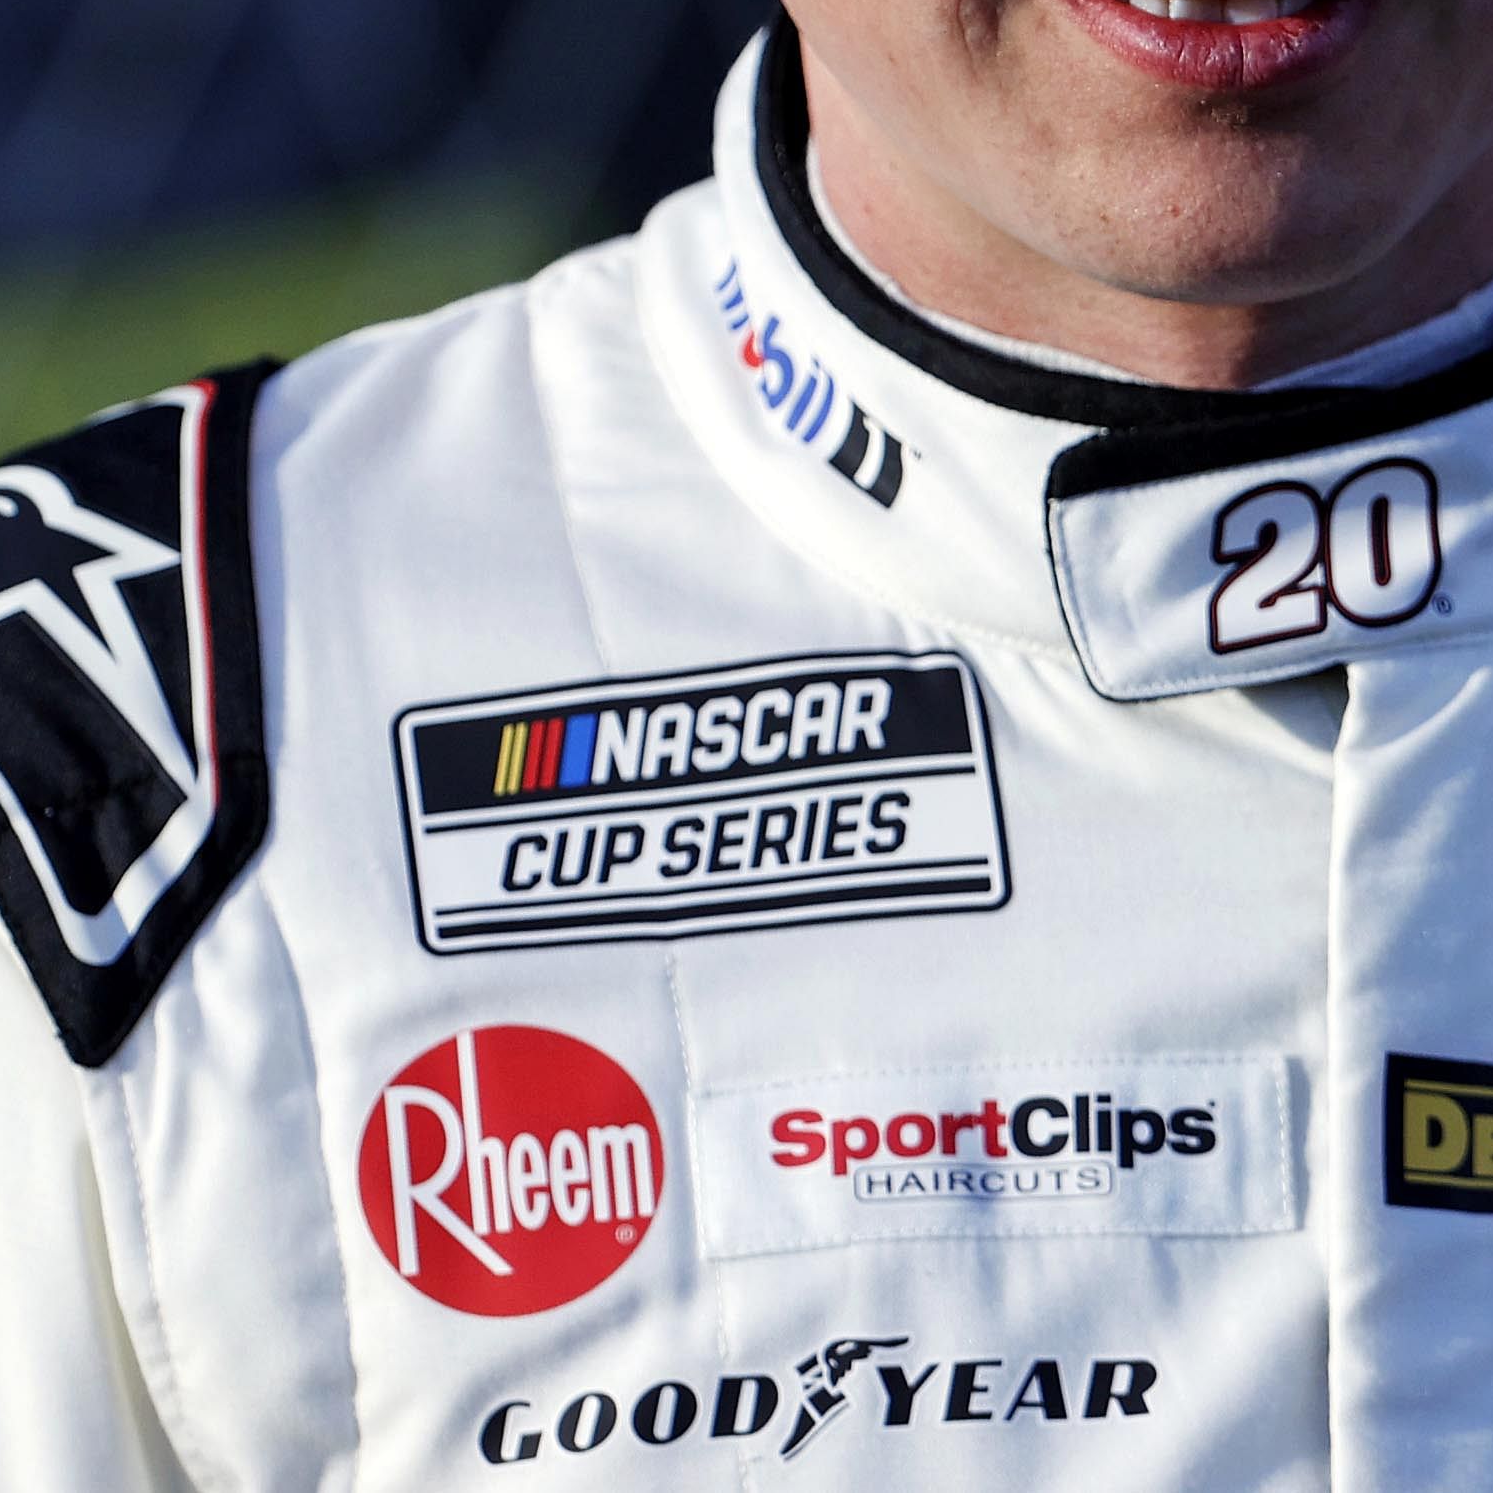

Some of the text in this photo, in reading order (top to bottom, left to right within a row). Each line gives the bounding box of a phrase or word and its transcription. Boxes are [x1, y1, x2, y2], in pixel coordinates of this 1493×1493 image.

[1209, 458, 1442, 655] 20
[592, 677, 893, 785] NASCAR
[500, 792, 911, 892] CUP SERIES
[383, 1028, 657, 1277] Rheem
[770, 1093, 1217, 1175] SportClips
[865, 1167, 1102, 1196] HAIRCUTS
